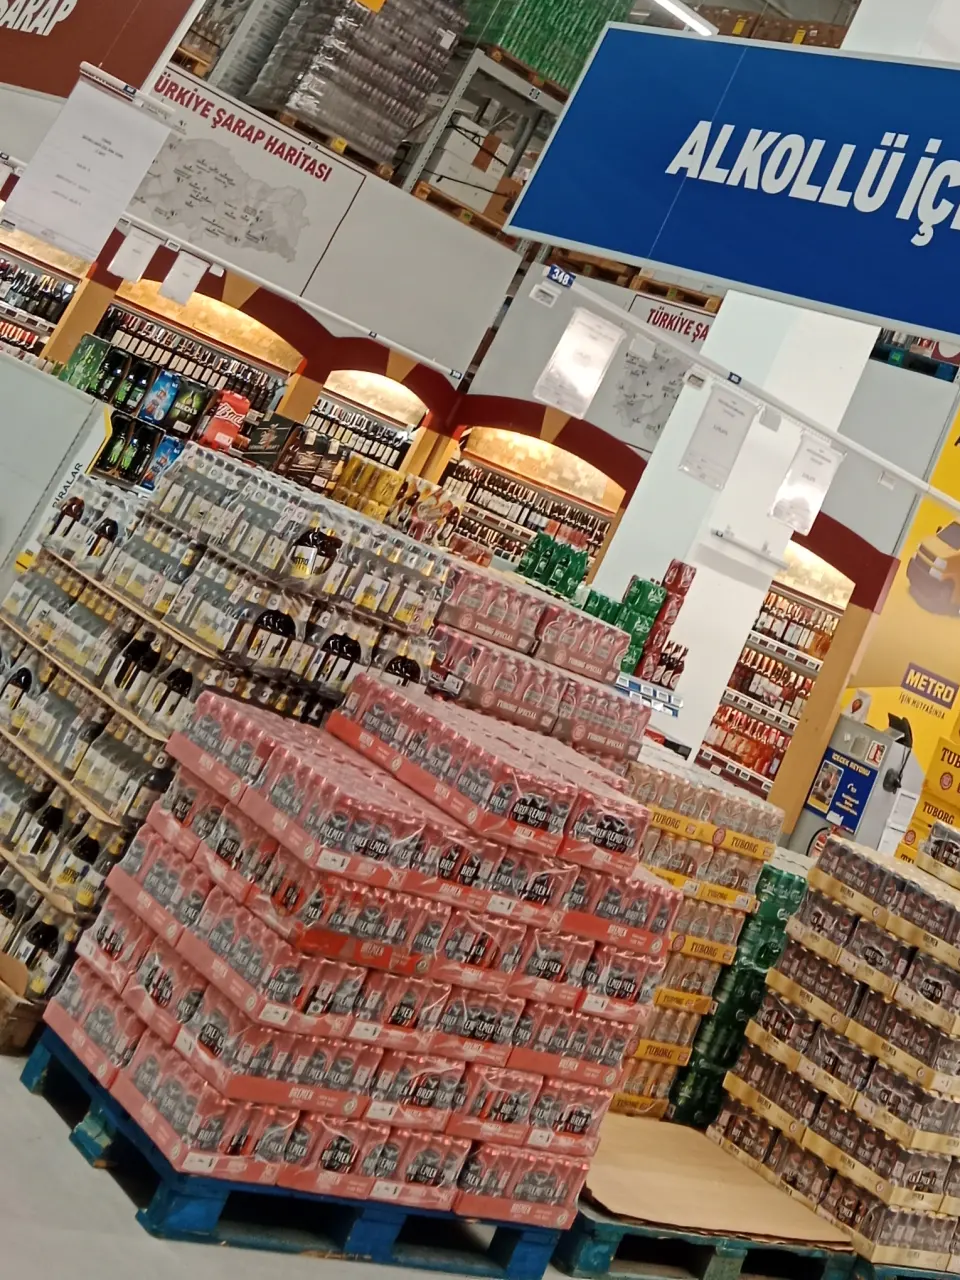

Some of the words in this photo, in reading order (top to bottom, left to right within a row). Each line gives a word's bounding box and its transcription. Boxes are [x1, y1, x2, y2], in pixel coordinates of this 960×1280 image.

[154, 71, 216, 119] ÜRKİYE
[211, 109, 267, 148] ŞARAP
[263, 133, 333, 183] HARİTASI
[664, 119, 910, 213] ALKOLLÜ
[551, 269, 570, 286] 348
[647, 306, 695, 336] TÜRKİYE
[691, 322, 710, 342] ŞA
[217, 403, 245, 424] Bud
[906, 669, 954, 703] METRO
[652, 812, 680, 829] TUBORG
[922, 802, 955, 825] TUBORG
[731, 837, 759, 853] TUBORG
[690, 942, 718, 957] TUBORG
[645, 1045, 673, 1059] TUBORG
